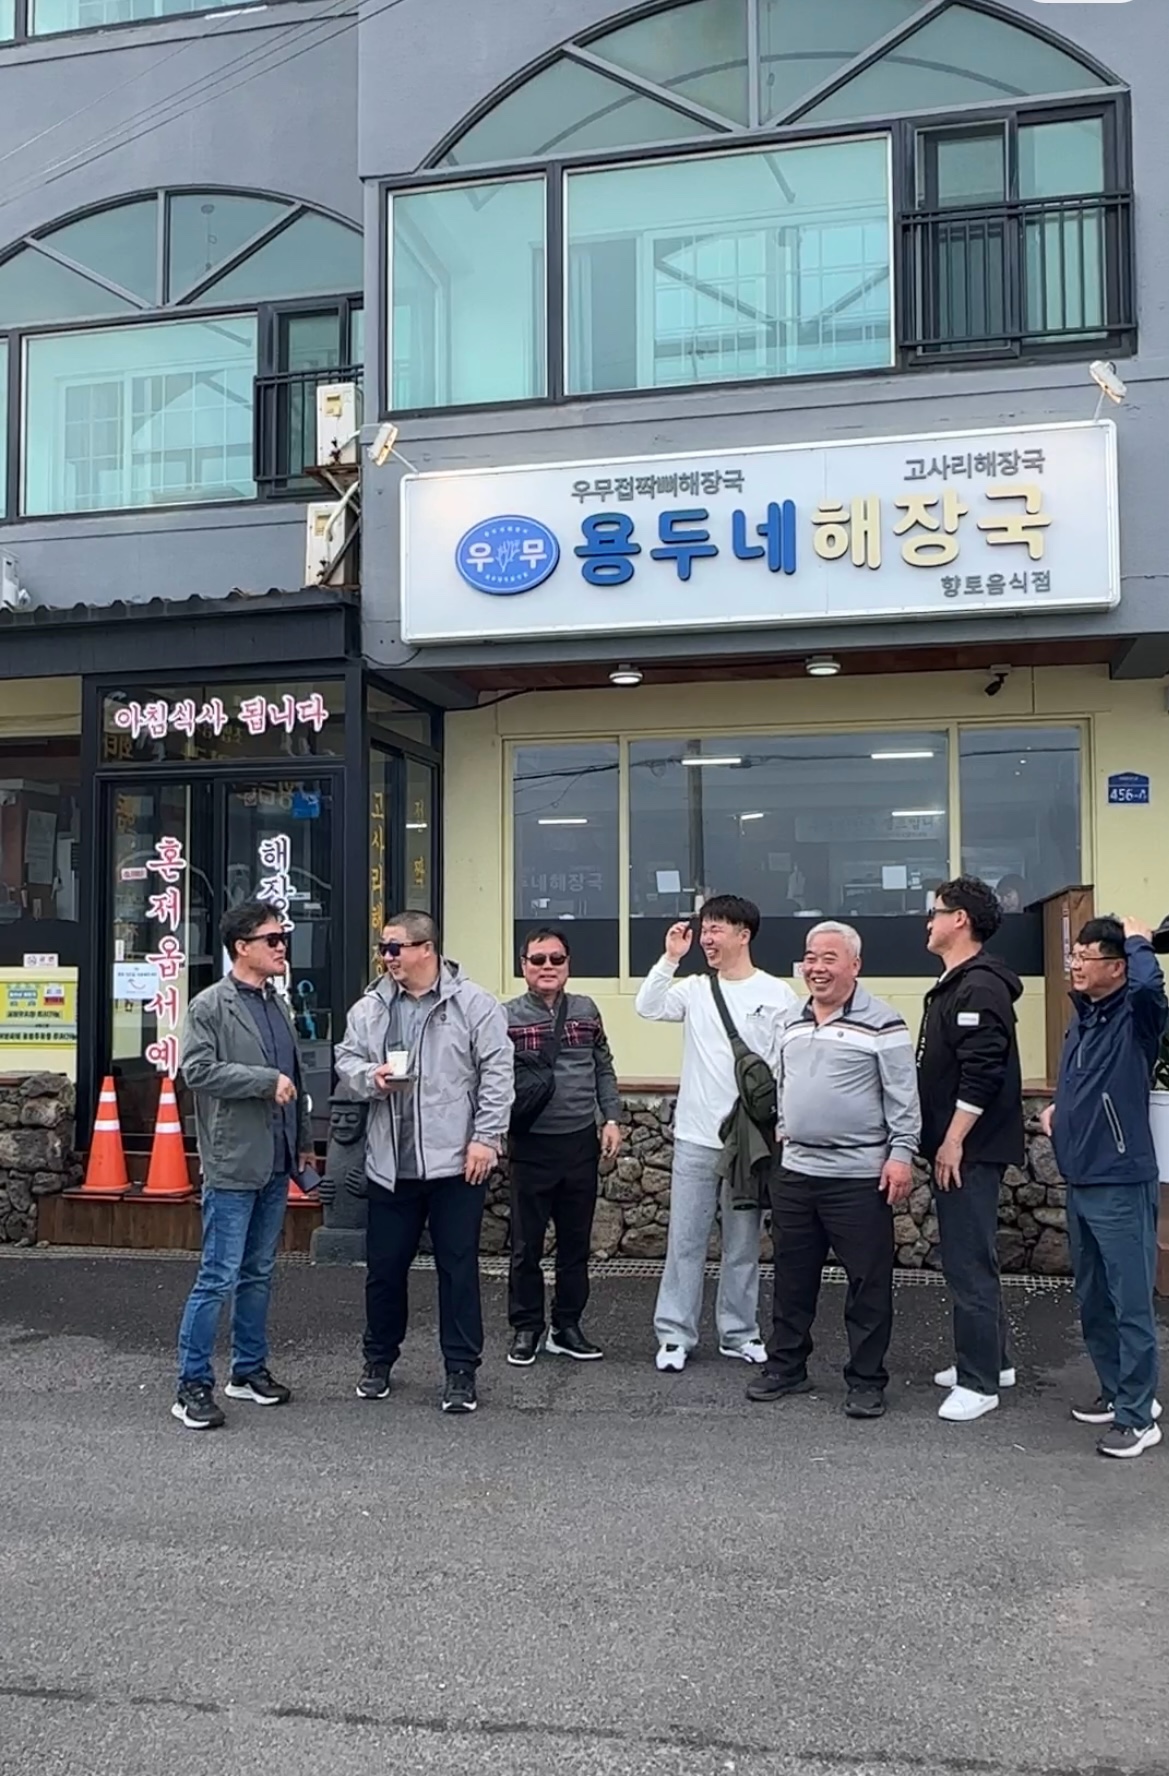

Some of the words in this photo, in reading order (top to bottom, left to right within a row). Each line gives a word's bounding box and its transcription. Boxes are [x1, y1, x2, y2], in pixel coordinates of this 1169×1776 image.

[904, 448, 1045, 481] 고사리해장국
[574, 499, 796, 586] 용두네
[811, 485, 1052, 570] 해장국
[941, 570, 1051, 598] 향토음식점
[114, 697, 228, 739] 아침식사
[238, 693, 328, 735] 됩니다
